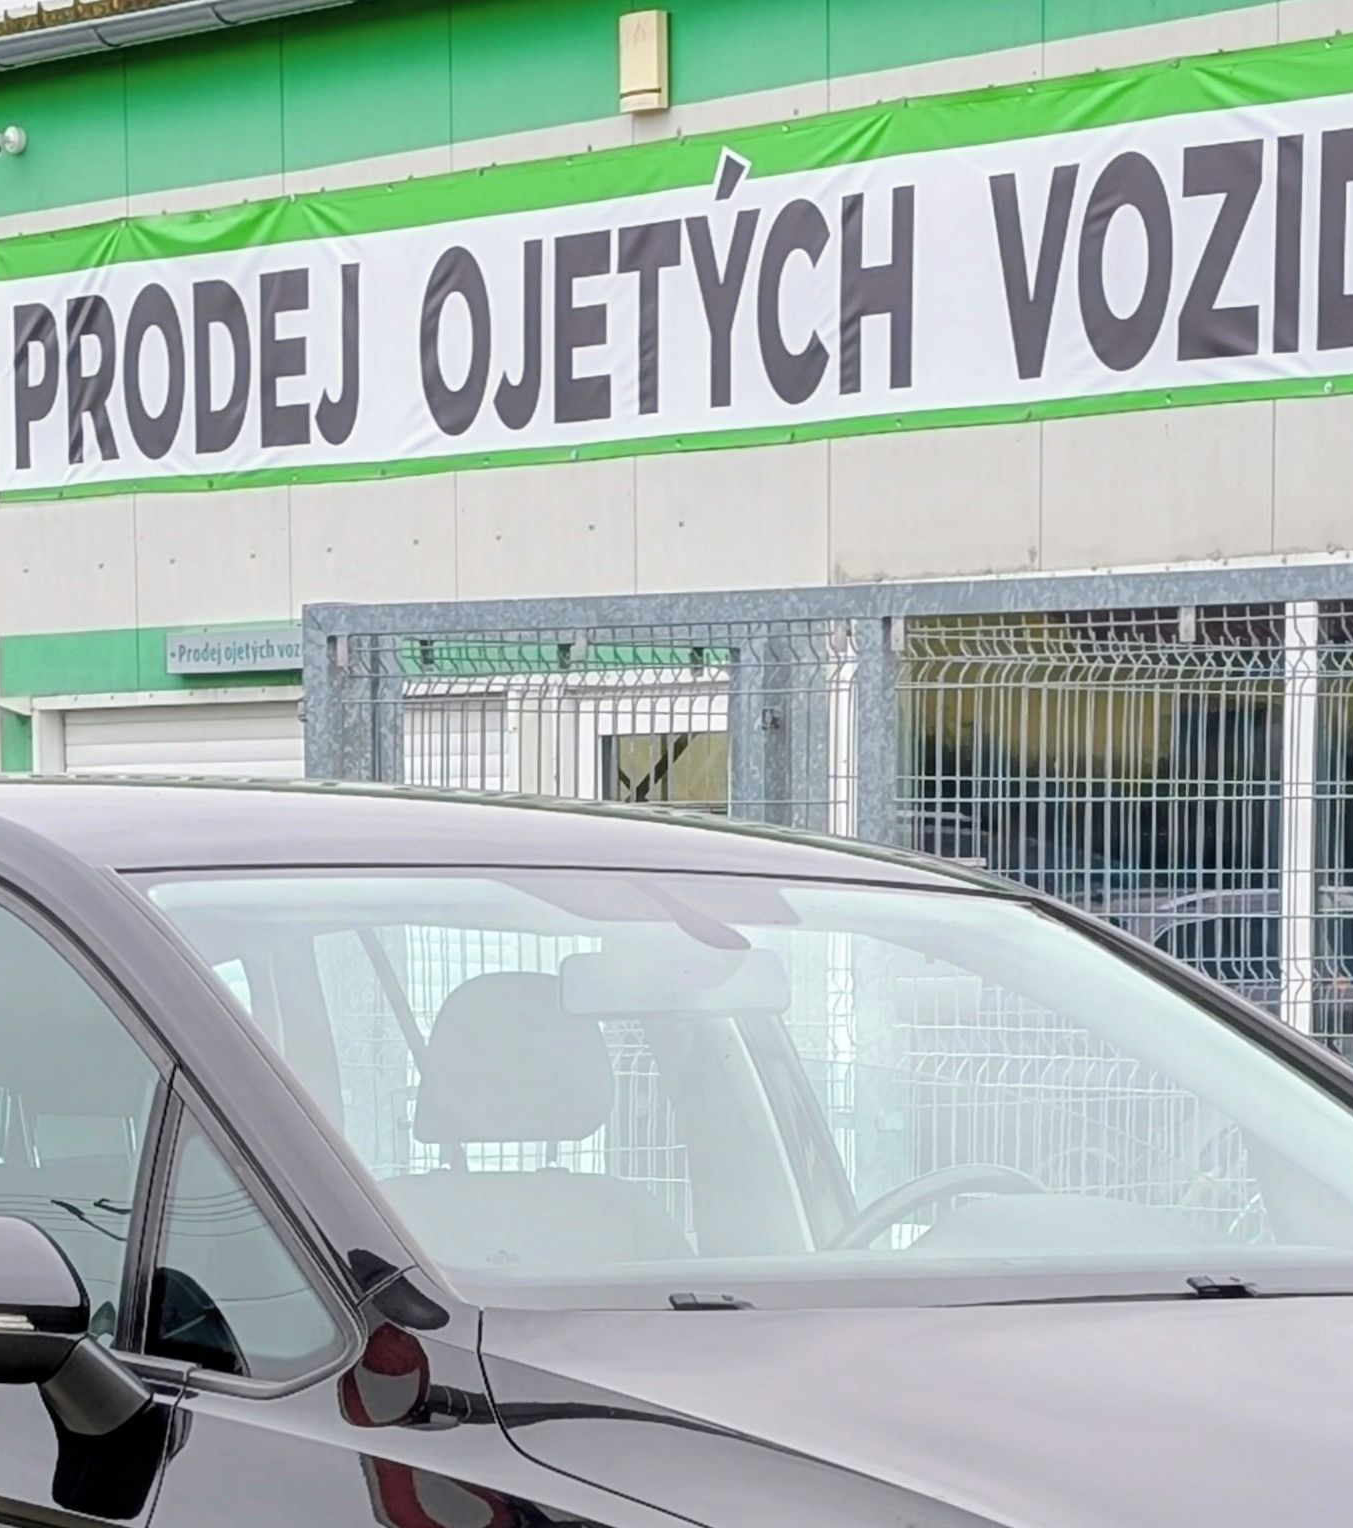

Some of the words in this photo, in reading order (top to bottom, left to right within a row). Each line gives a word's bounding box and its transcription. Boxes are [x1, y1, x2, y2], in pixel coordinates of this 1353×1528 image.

[12, 263, 360, 470] PRODEJ
[420, 150, 914, 436] OJETÝCH
[178, 642, 222, 666] Prodej
[224, 638, 275, 665] ojetých
